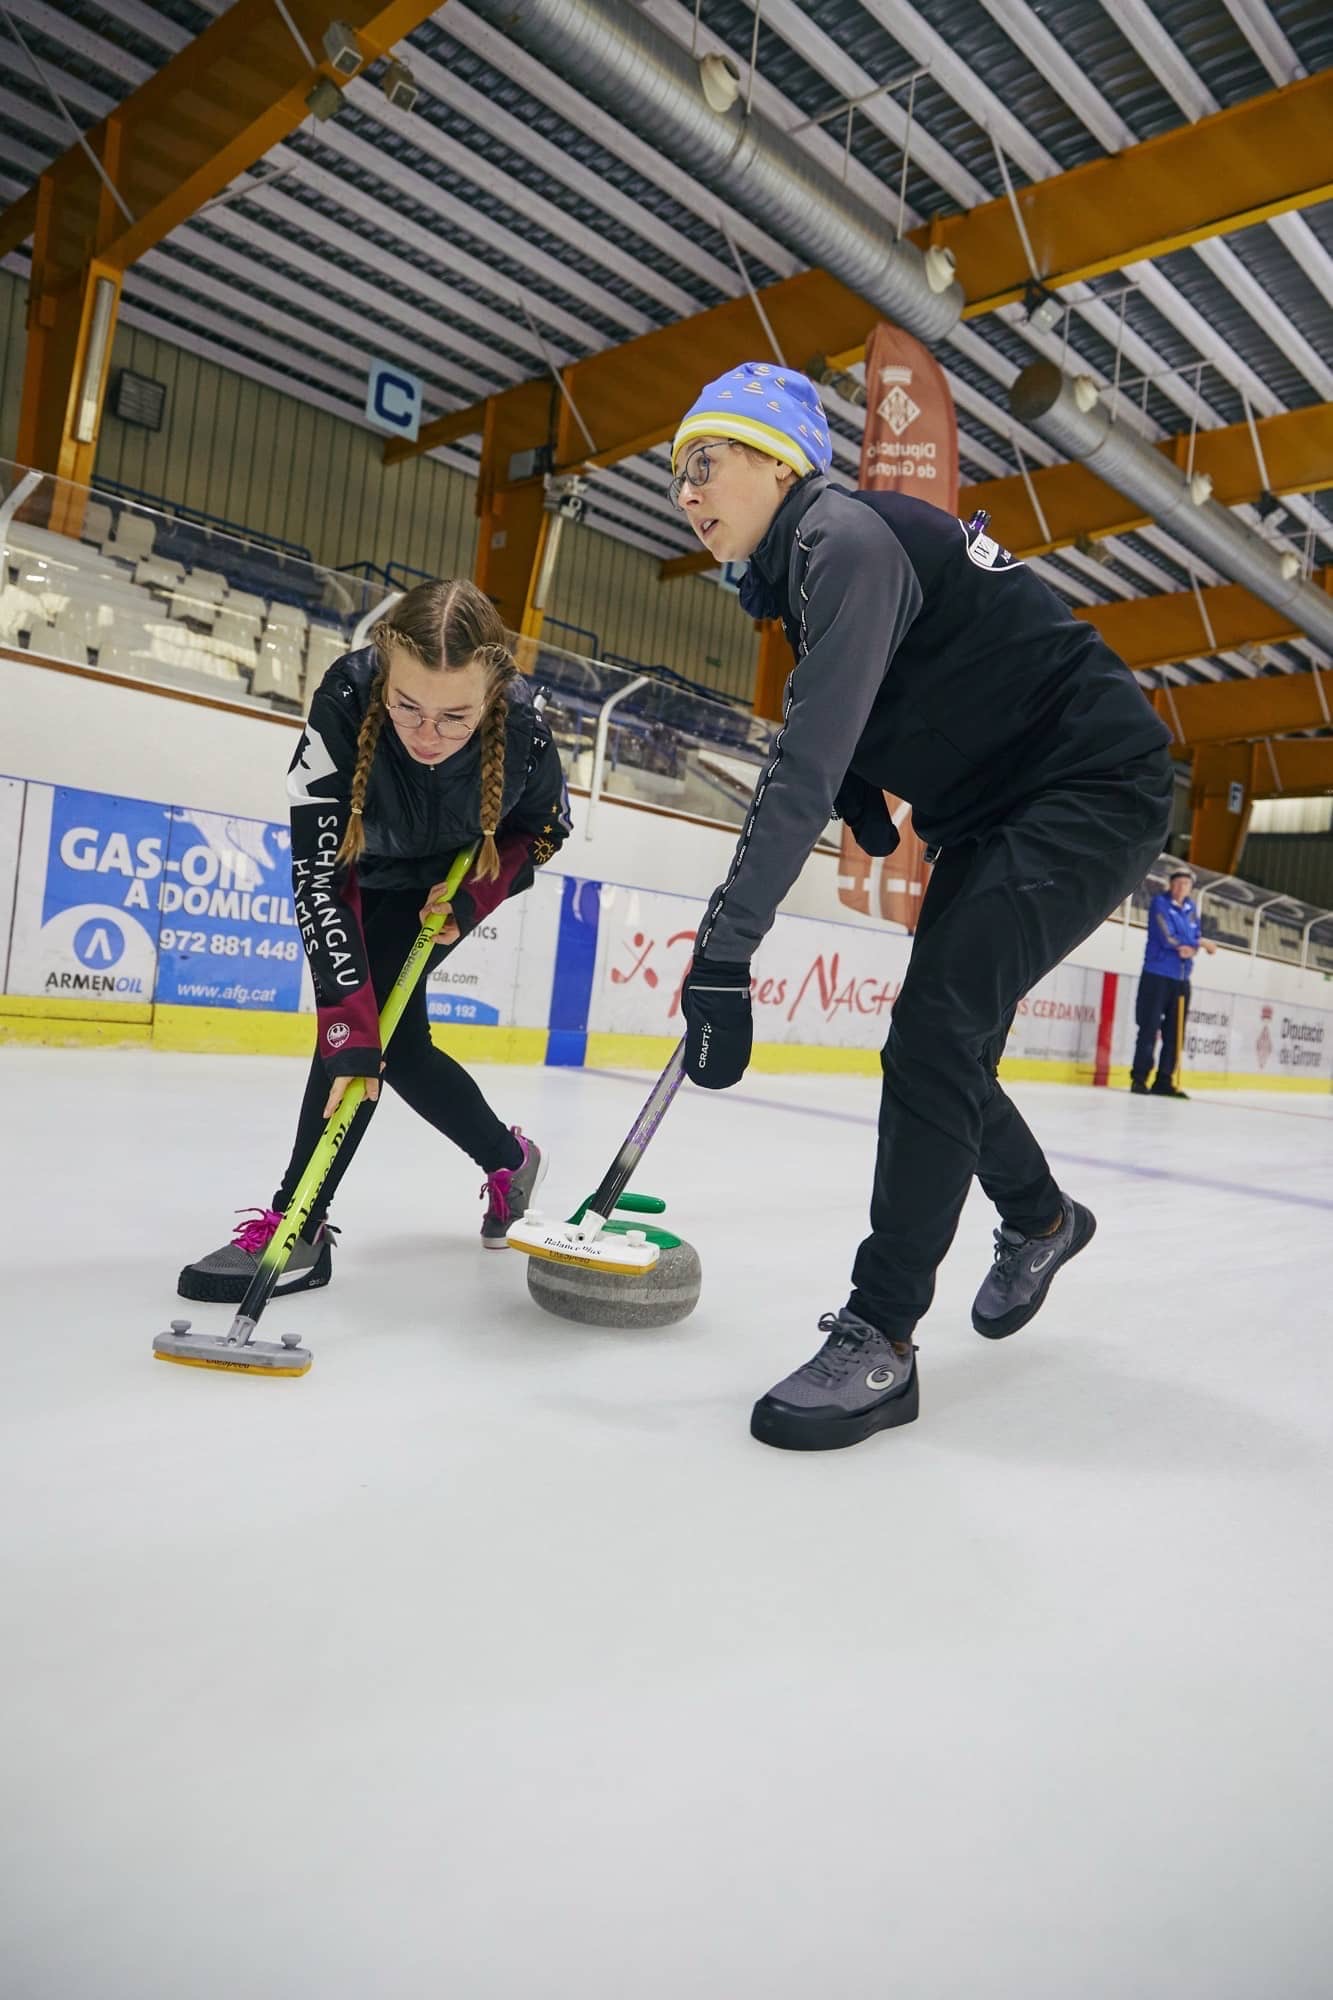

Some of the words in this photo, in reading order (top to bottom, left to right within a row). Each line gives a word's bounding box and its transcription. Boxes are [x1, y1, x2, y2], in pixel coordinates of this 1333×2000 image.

[374, 371, 415, 428] C
[60, 826, 257, 892] GAS-OIL
[123, 878, 149, 911] A
[158, 881, 299, 927] DOMICIL
[312, 814, 359, 988] SCHWANGAU
[159, 928, 205, 954] 972
[209, 931, 251, 957] 881
[255, 936, 299, 962] 448
[45, 971, 144, 995] ARMENOIL
[177, 981, 277, 1003] www.afg.cat
[432, 969, 479, 985] da.com
[698, 1032, 711, 1069] CRAFT
